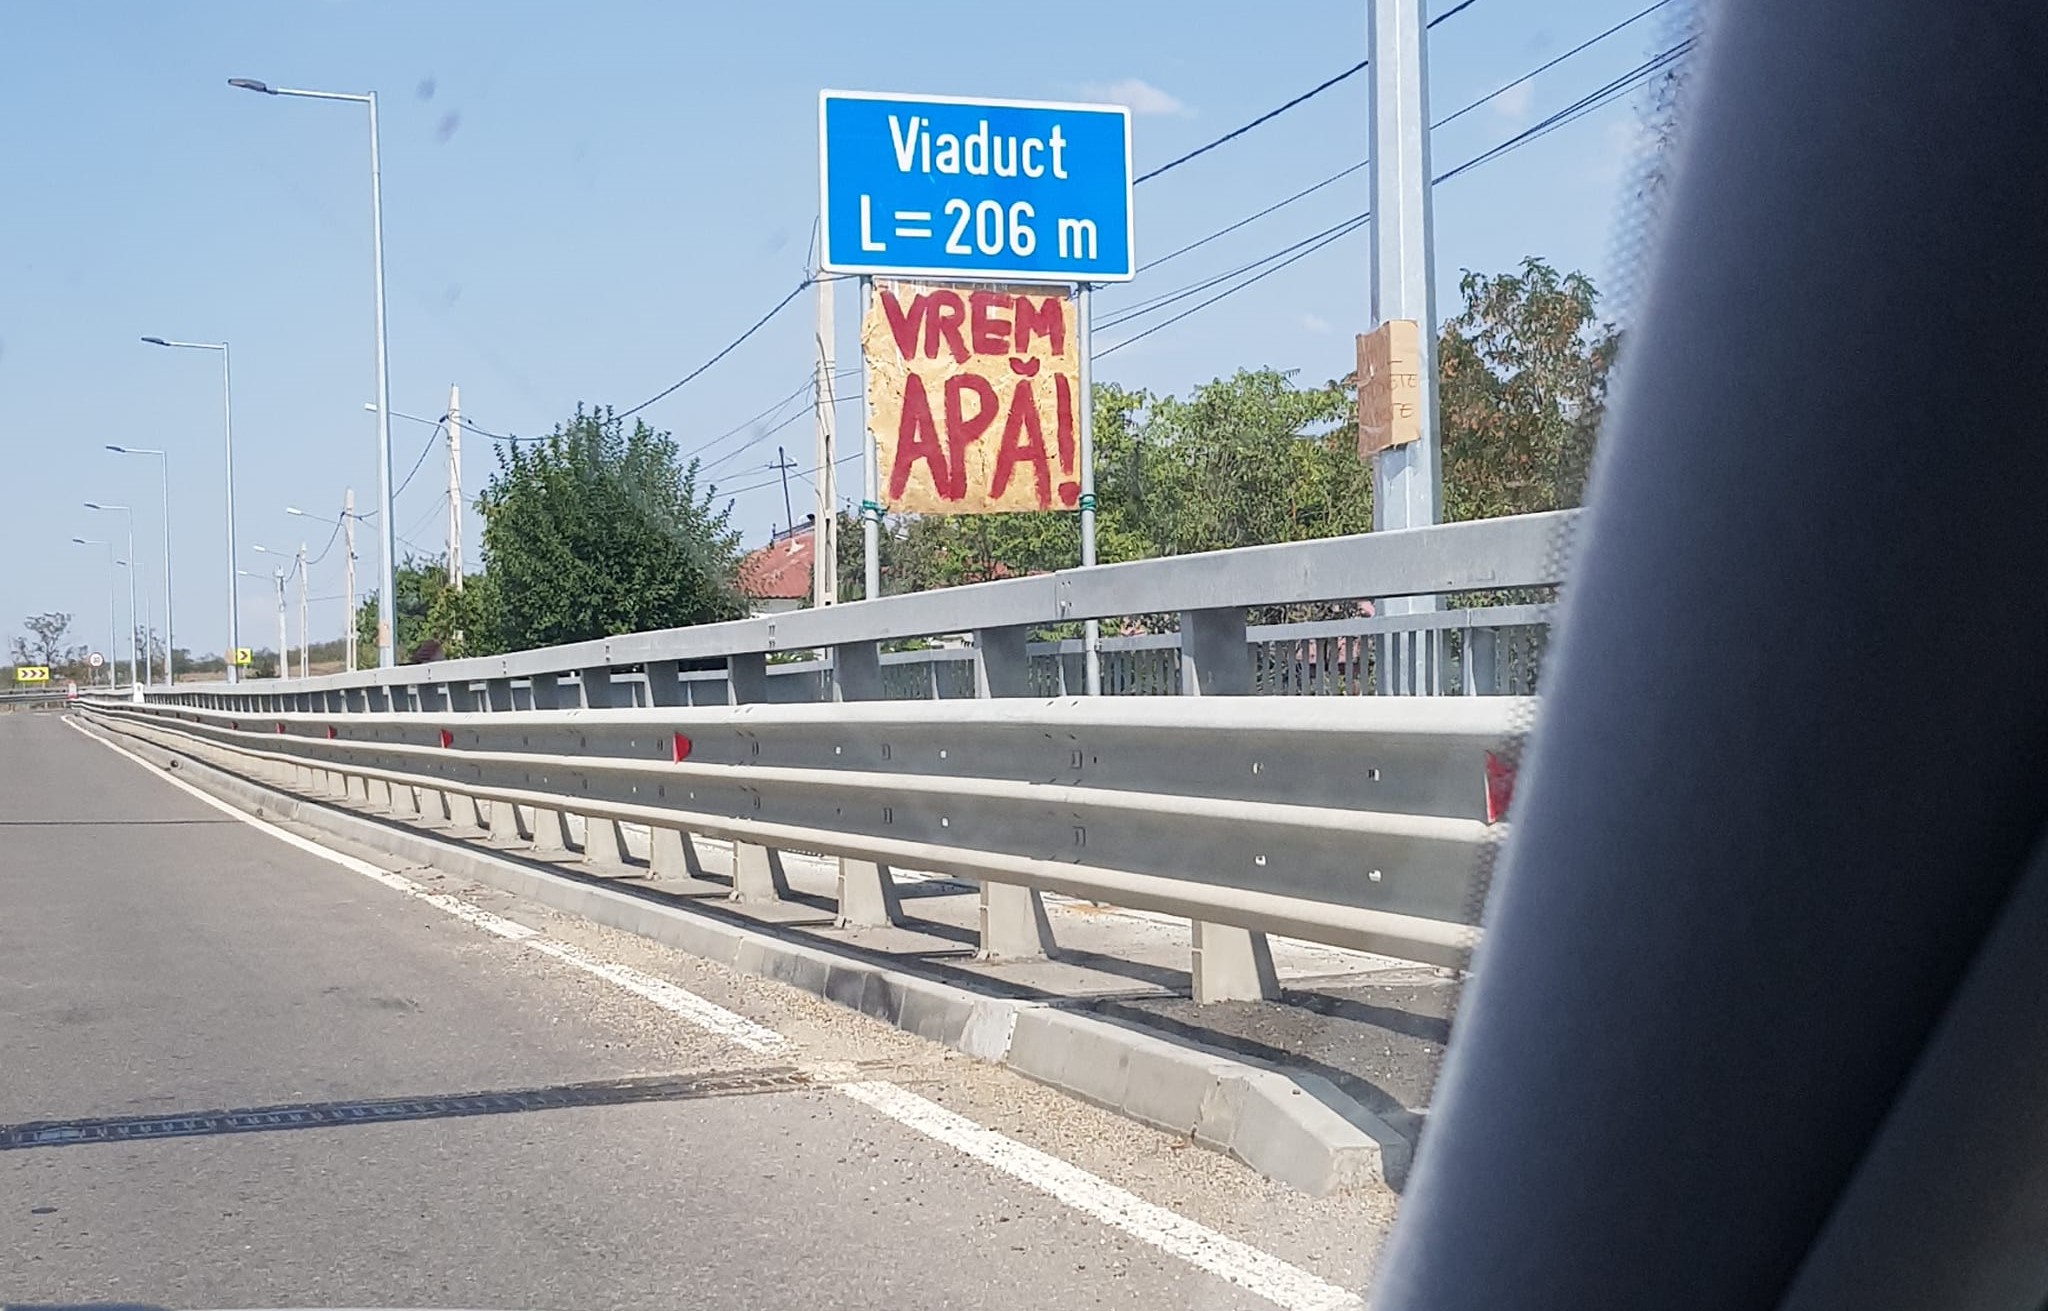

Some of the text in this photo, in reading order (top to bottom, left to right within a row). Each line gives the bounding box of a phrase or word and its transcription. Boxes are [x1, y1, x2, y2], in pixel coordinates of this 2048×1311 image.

[888, 114, 1068, 180] Viaduct
[1057, 217, 1097, 260] m
[880, 290, 1065, 364] VREM
[888, 356, 1081, 510] APĂ!
